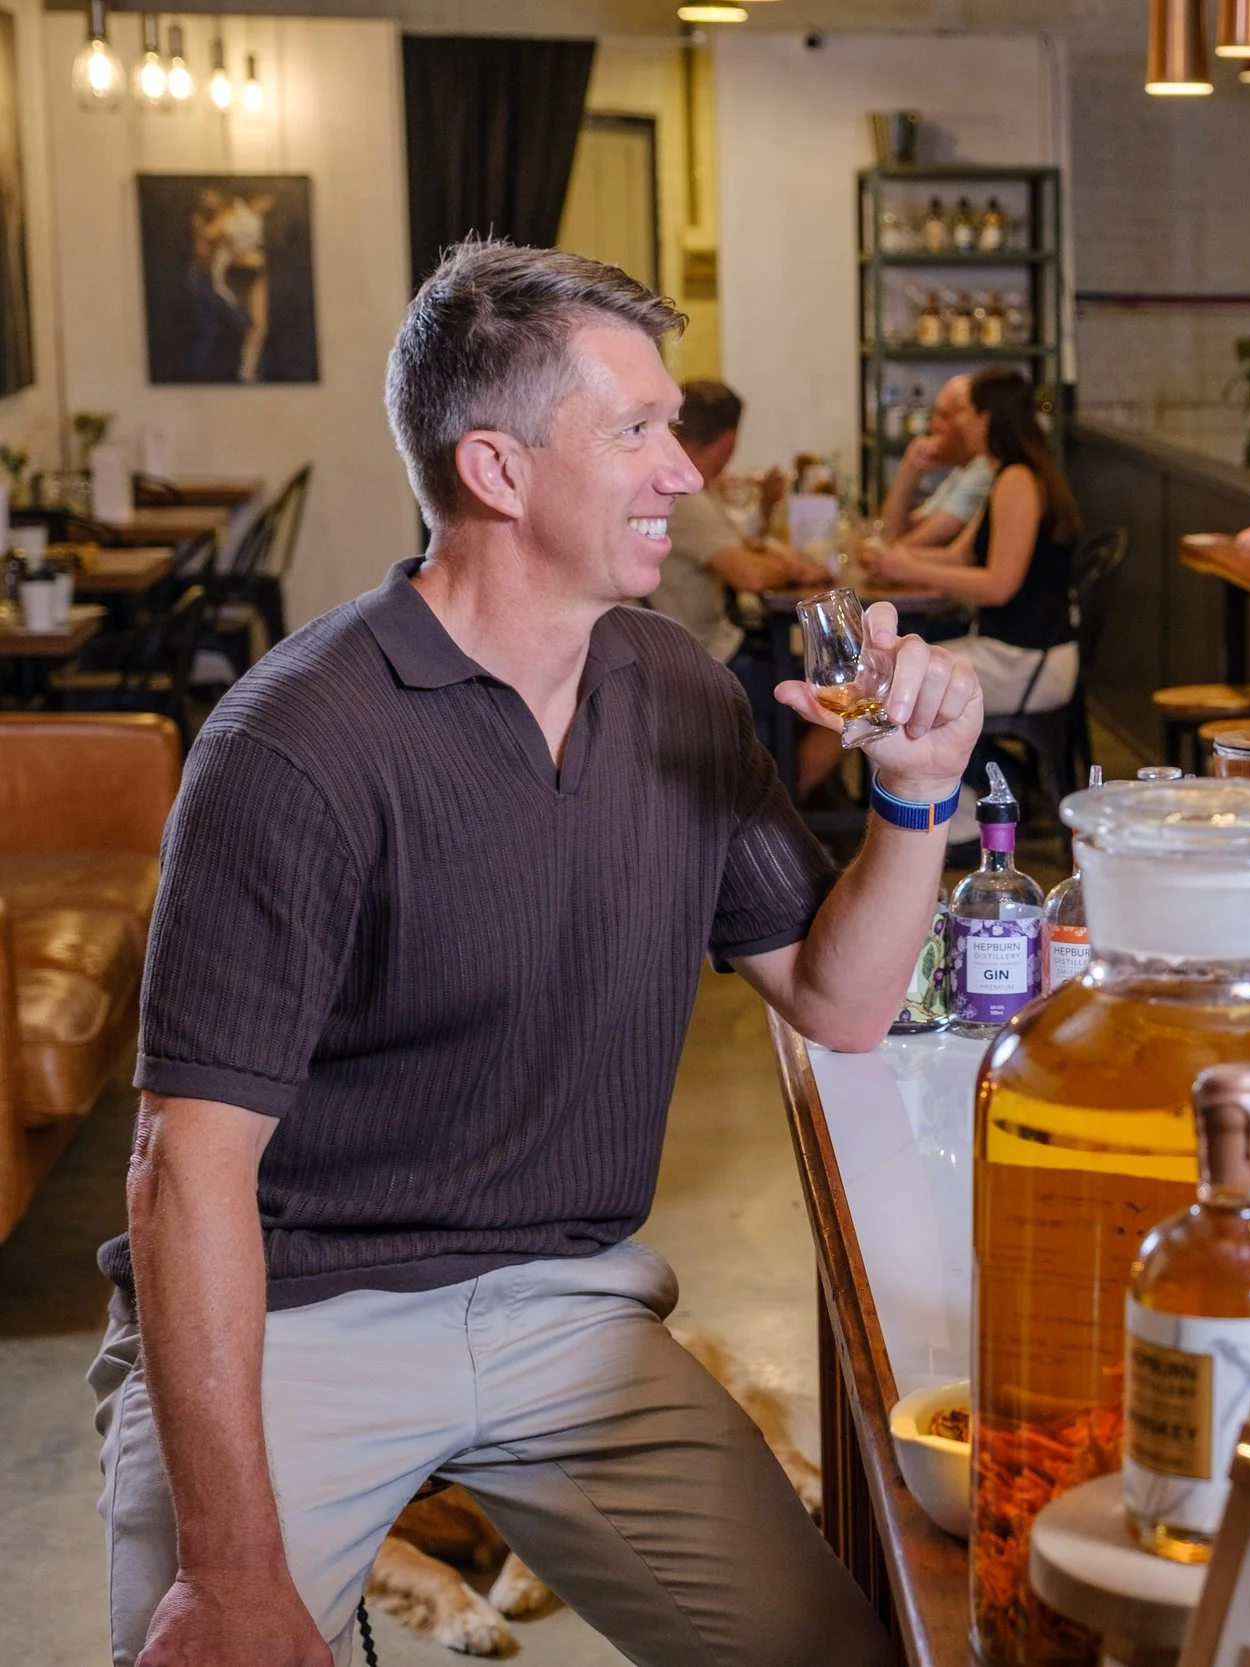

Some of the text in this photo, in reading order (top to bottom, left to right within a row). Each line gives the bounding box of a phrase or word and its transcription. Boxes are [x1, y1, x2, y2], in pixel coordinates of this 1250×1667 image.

[973, 942, 1021, 951] HEPBURN
[1054, 946, 1091, 957] HEPBUR
[973, 952, 1020, 961] DISTILLERY
[1054, 956, 1087, 966] DISTILLE
[983, 969, 1009, 980] GIN
